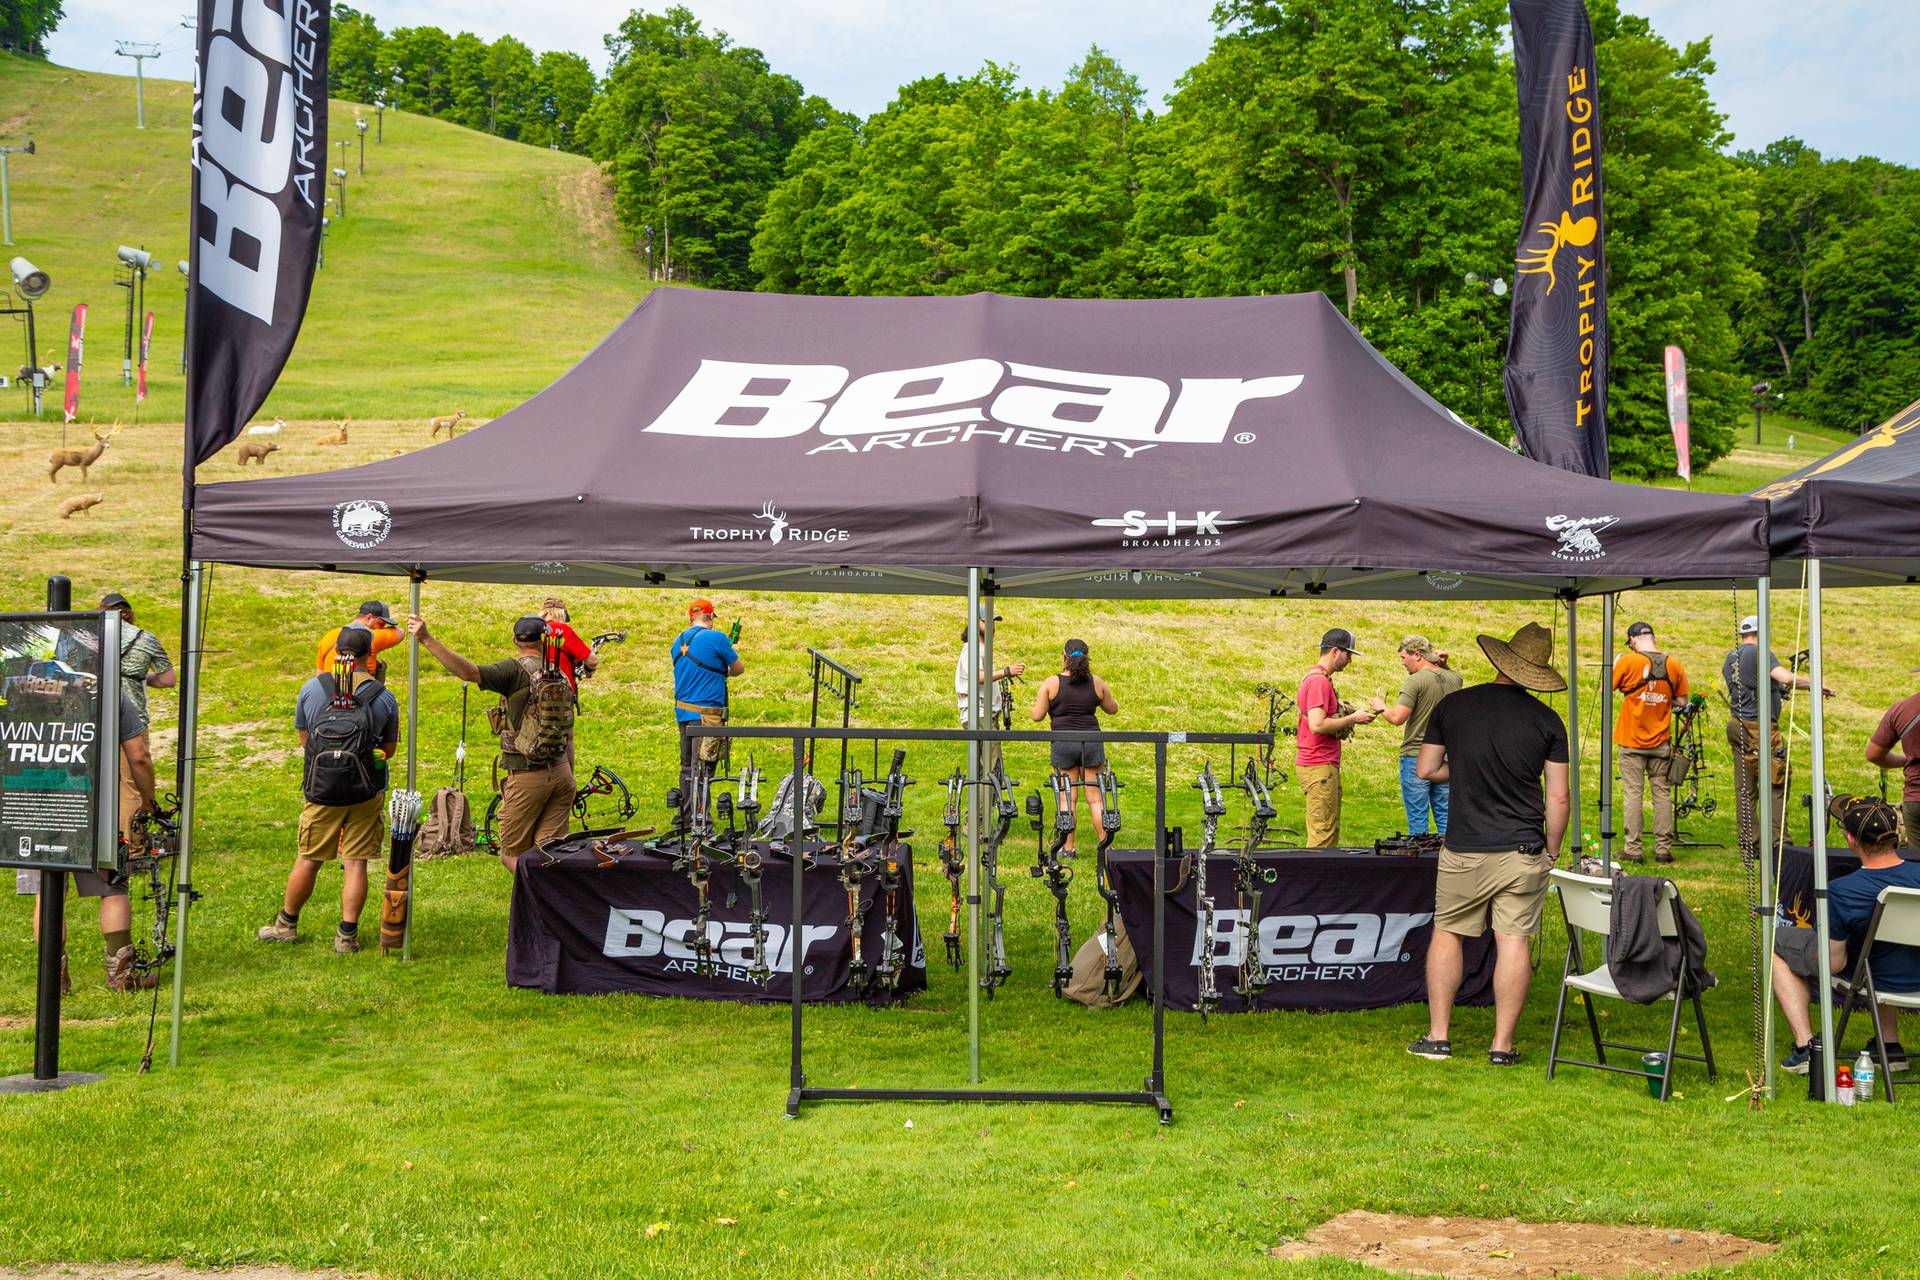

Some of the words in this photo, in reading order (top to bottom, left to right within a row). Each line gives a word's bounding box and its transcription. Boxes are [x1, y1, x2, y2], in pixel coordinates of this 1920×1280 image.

[1566, 66, 1594, 206] RIDGE
[1576, 256, 1596, 427] TROPHY
[642, 359, 1304, 443] Bear
[805, 424, 1158, 458] ARCHERY
[690, 527, 766, 540] TROPHY
[787, 528, 849, 543] RIDGE
[1122, 539, 1221, 547] BROADHEADS
[0, 722, 44, 740] WIN
[48, 722, 96, 742] THIS
[7, 743, 88, 763] TRUCK
[602, 905, 838, 973] Bear
[1190, 909, 1433, 966] Bear
